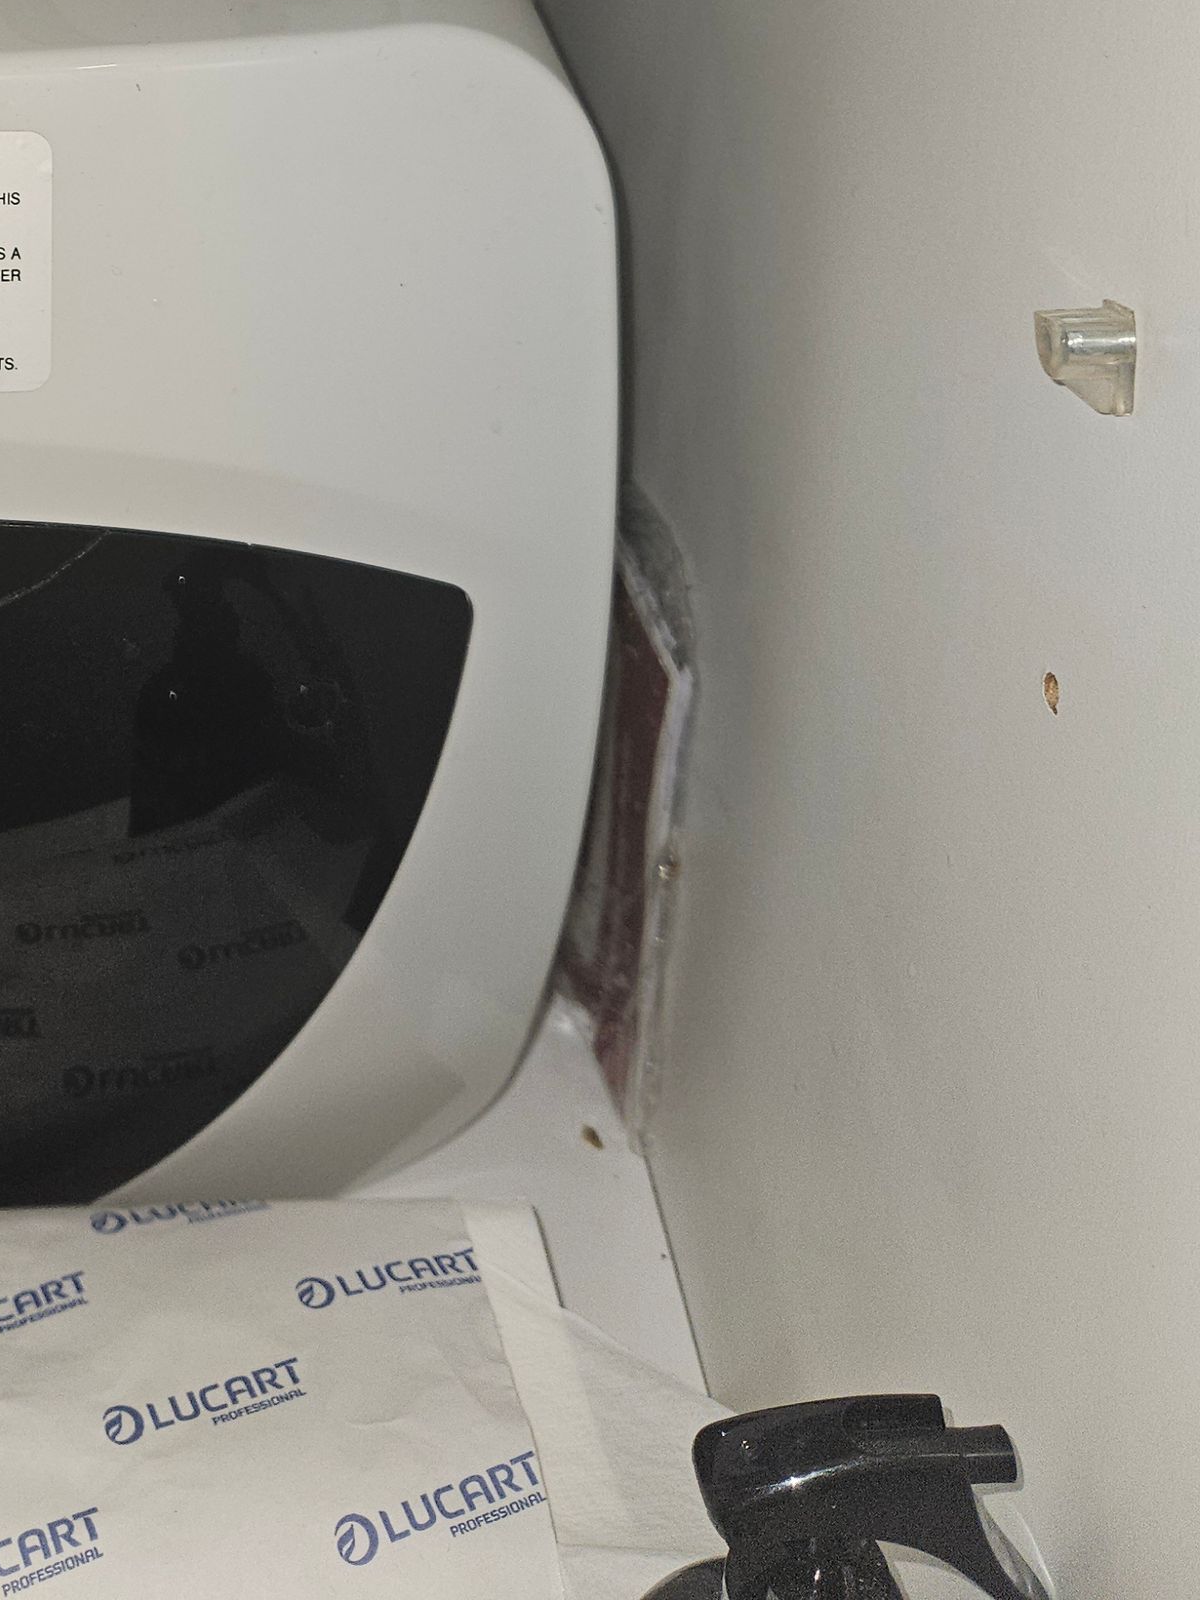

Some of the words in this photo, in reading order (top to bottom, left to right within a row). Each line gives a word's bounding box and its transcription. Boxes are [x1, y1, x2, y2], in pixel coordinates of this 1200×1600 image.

[10, 247, 21, 260] A
[335, 1246, 479, 1297] LUCART
[144, 1356, 301, 1430] LUCART
[212, 1384, 307, 1427] PROFESSIONAL
[378, 1450, 540, 1543] LUCART
[449, 1490, 548, 1538] PROFESSIONAL
[1, 1546, 104, 1597] PROFESSIONAL
